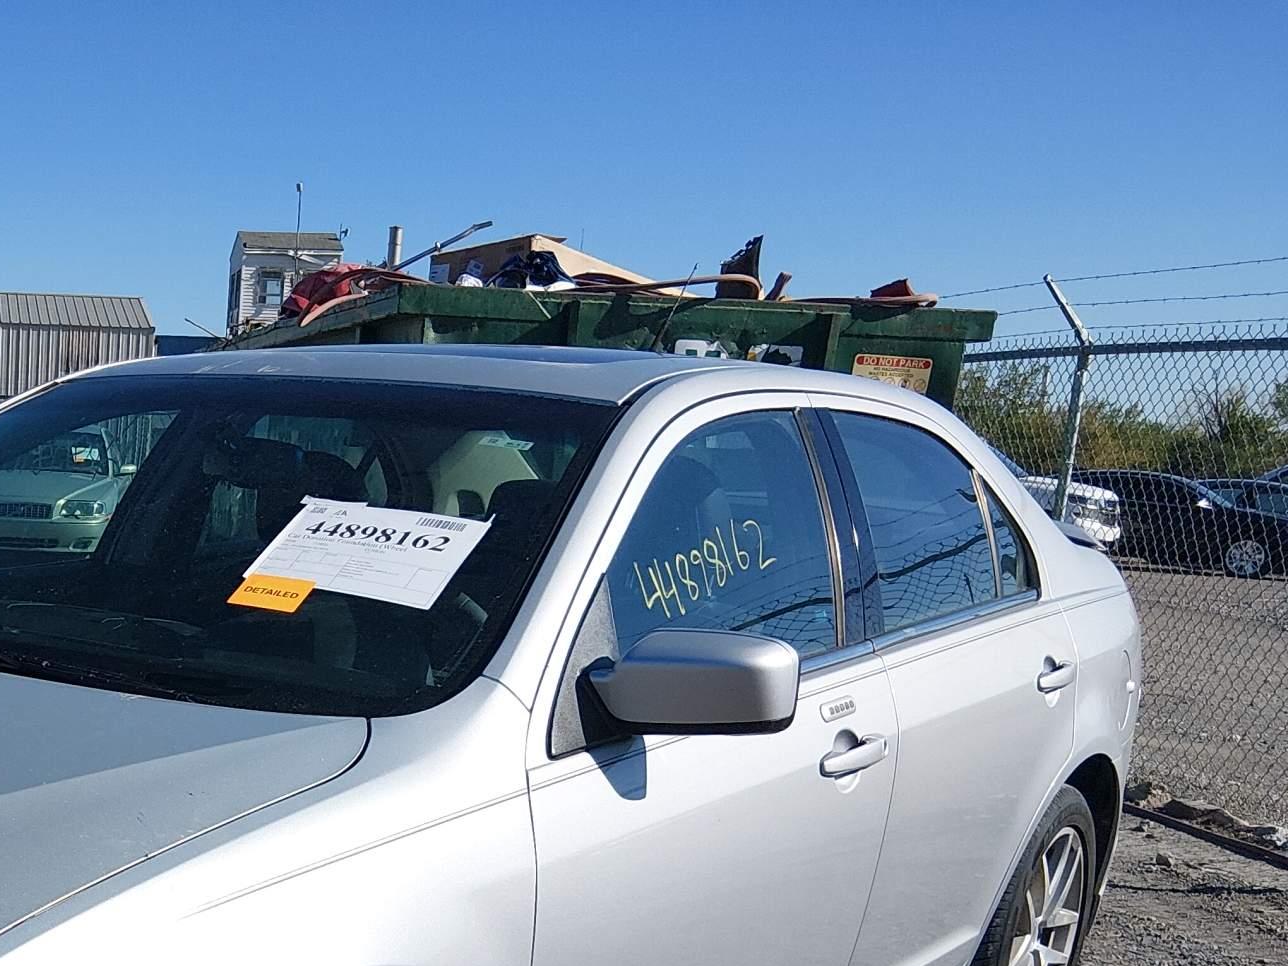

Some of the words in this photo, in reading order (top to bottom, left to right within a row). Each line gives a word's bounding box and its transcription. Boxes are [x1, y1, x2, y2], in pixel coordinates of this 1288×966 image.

[863, 356, 877, 365] DO
[879, 357, 898, 366] NOT
[899, 359, 926, 368] PARK
[305, 520, 451, 552] 44898162
[633, 518, 777, 618] 44898162
[244, 586, 300, 599] DETAILED
